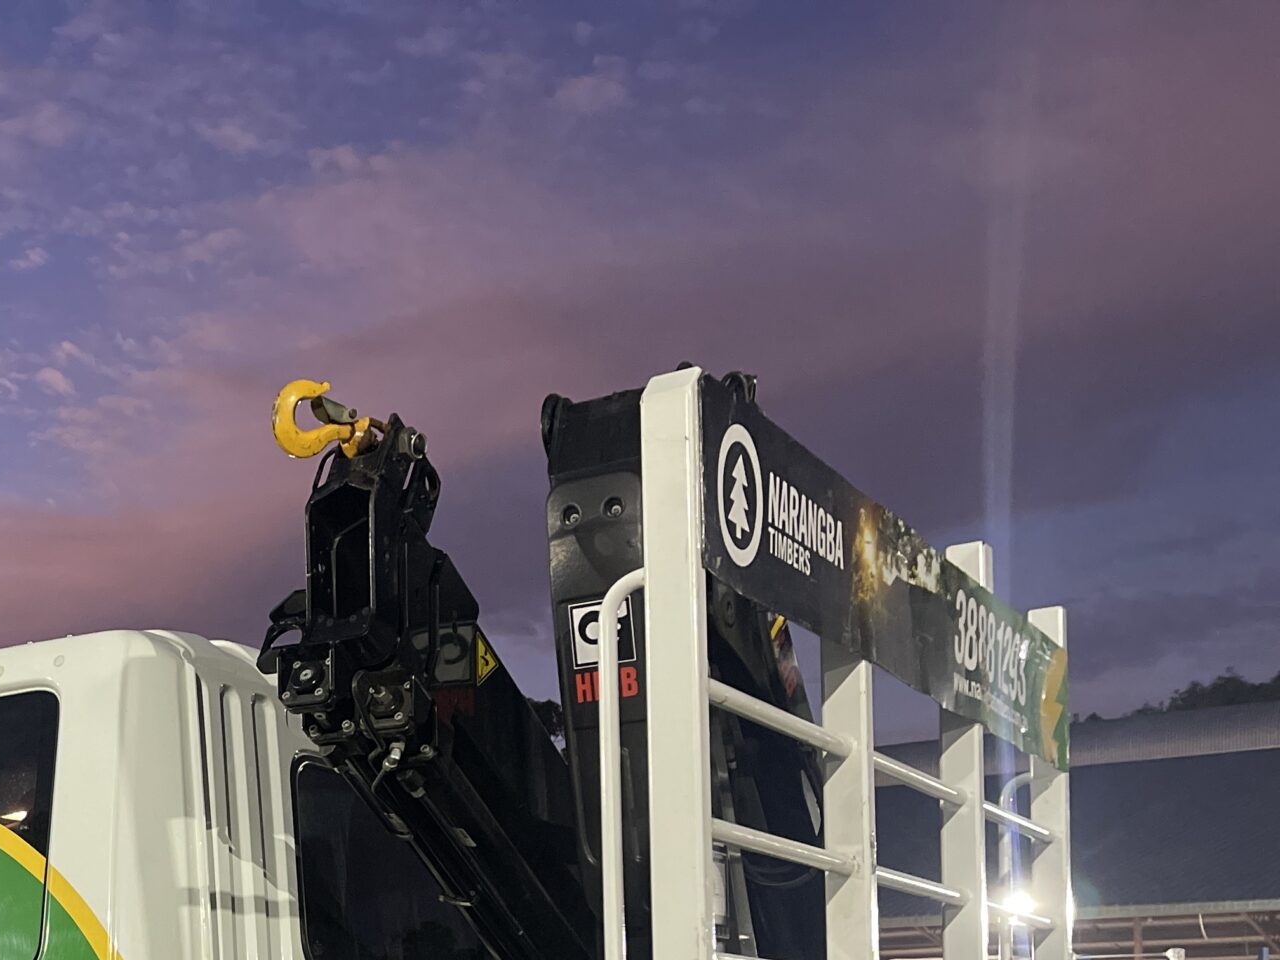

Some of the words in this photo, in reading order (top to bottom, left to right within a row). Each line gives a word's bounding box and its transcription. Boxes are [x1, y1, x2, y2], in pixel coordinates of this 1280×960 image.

[768, 472, 844, 570] NARANGBA
[768, 526, 811, 576] TIMBERS
[954, 589, 1029, 706] 38881293
[575, 667, 639, 704] HIB
